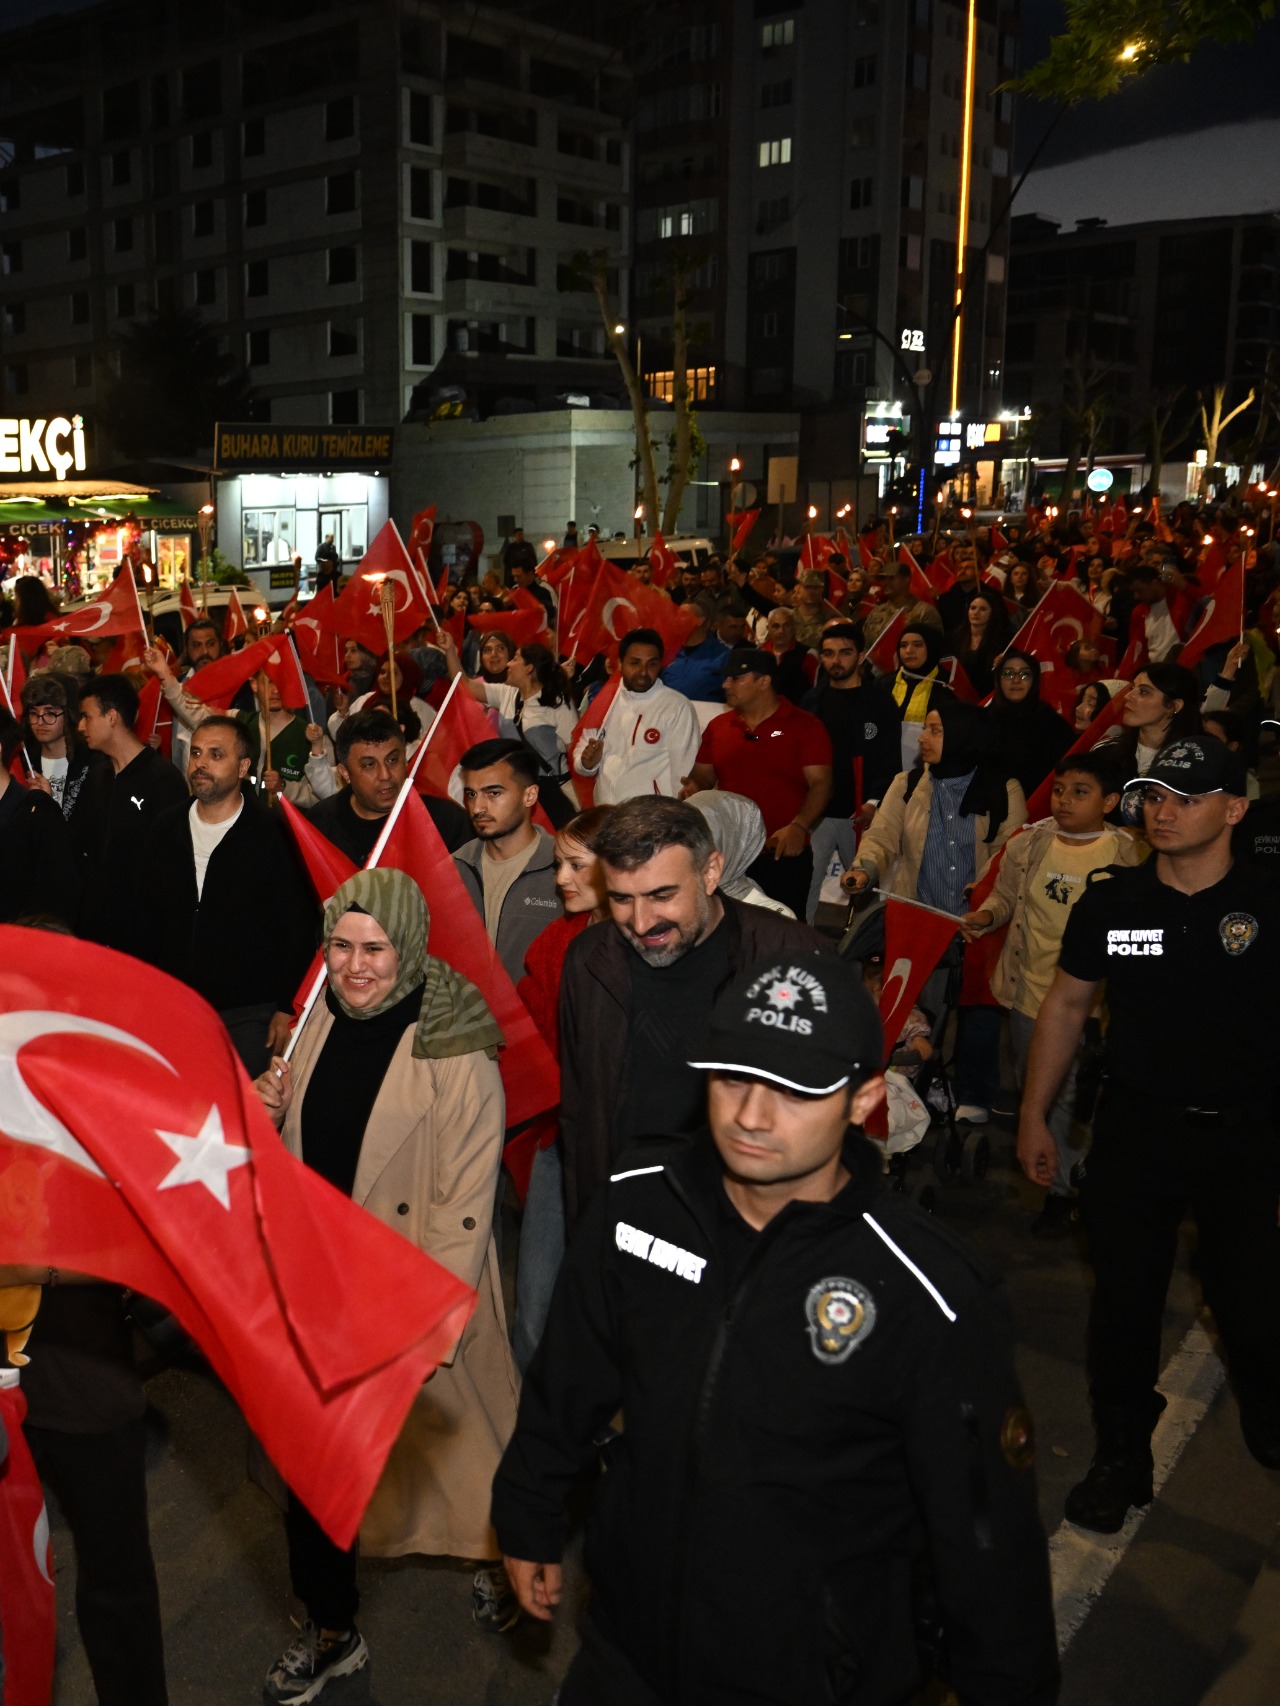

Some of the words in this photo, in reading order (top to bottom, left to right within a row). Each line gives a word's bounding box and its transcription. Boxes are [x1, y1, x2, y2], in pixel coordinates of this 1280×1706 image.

[221, 433, 279, 458] BUHARA
[283, 434, 319, 458] KURU
[322, 429, 391, 458] TEMİZLEME
[10, 522, 66, 537] ÇİÇEK
[1254, 846, 1280, 855] POL
[530, 897, 558, 909] Columbia
[1131, 929, 1164, 942] KUVVET
[648, 1237, 708, 1284] KUVVET
